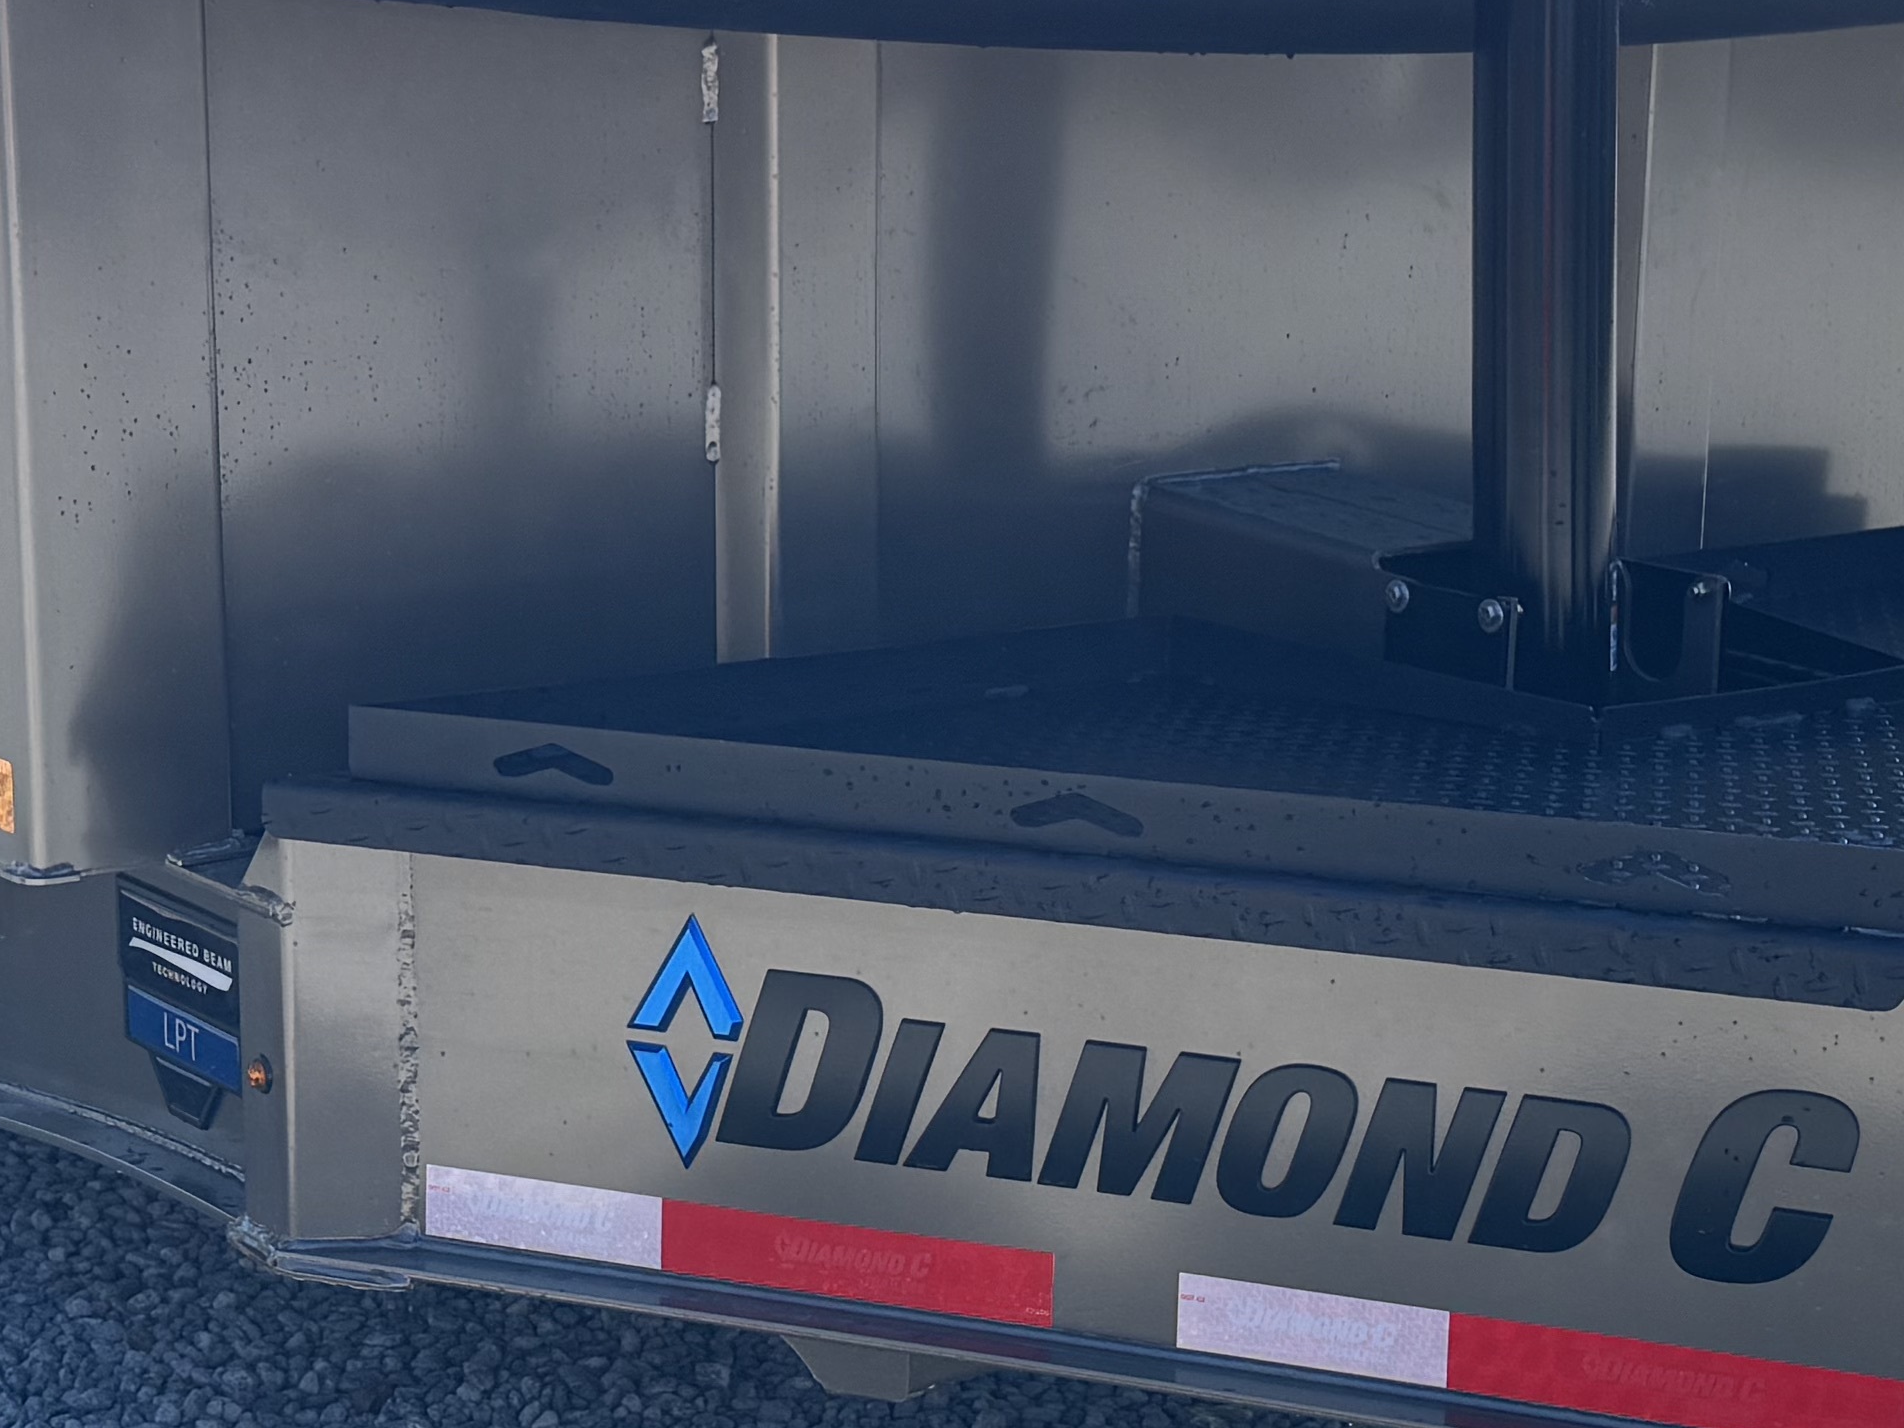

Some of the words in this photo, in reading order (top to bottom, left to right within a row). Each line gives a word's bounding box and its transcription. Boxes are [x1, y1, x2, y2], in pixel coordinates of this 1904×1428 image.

[133, 917, 199, 958] ENGINEERED
[203, 948, 232, 973] BEAM
[152, 961, 208, 994] TECHNOLOGY
[164, 1011, 199, 1062] LPT
[715, 968, 1633, 1253] DIAMOND
[1669, 1088, 1861, 1284] C
[792, 1237, 906, 1275] DIAMOND
[910, 1253, 932, 1278] C
[1603, 1357, 1734, 1398] DIAMOND
